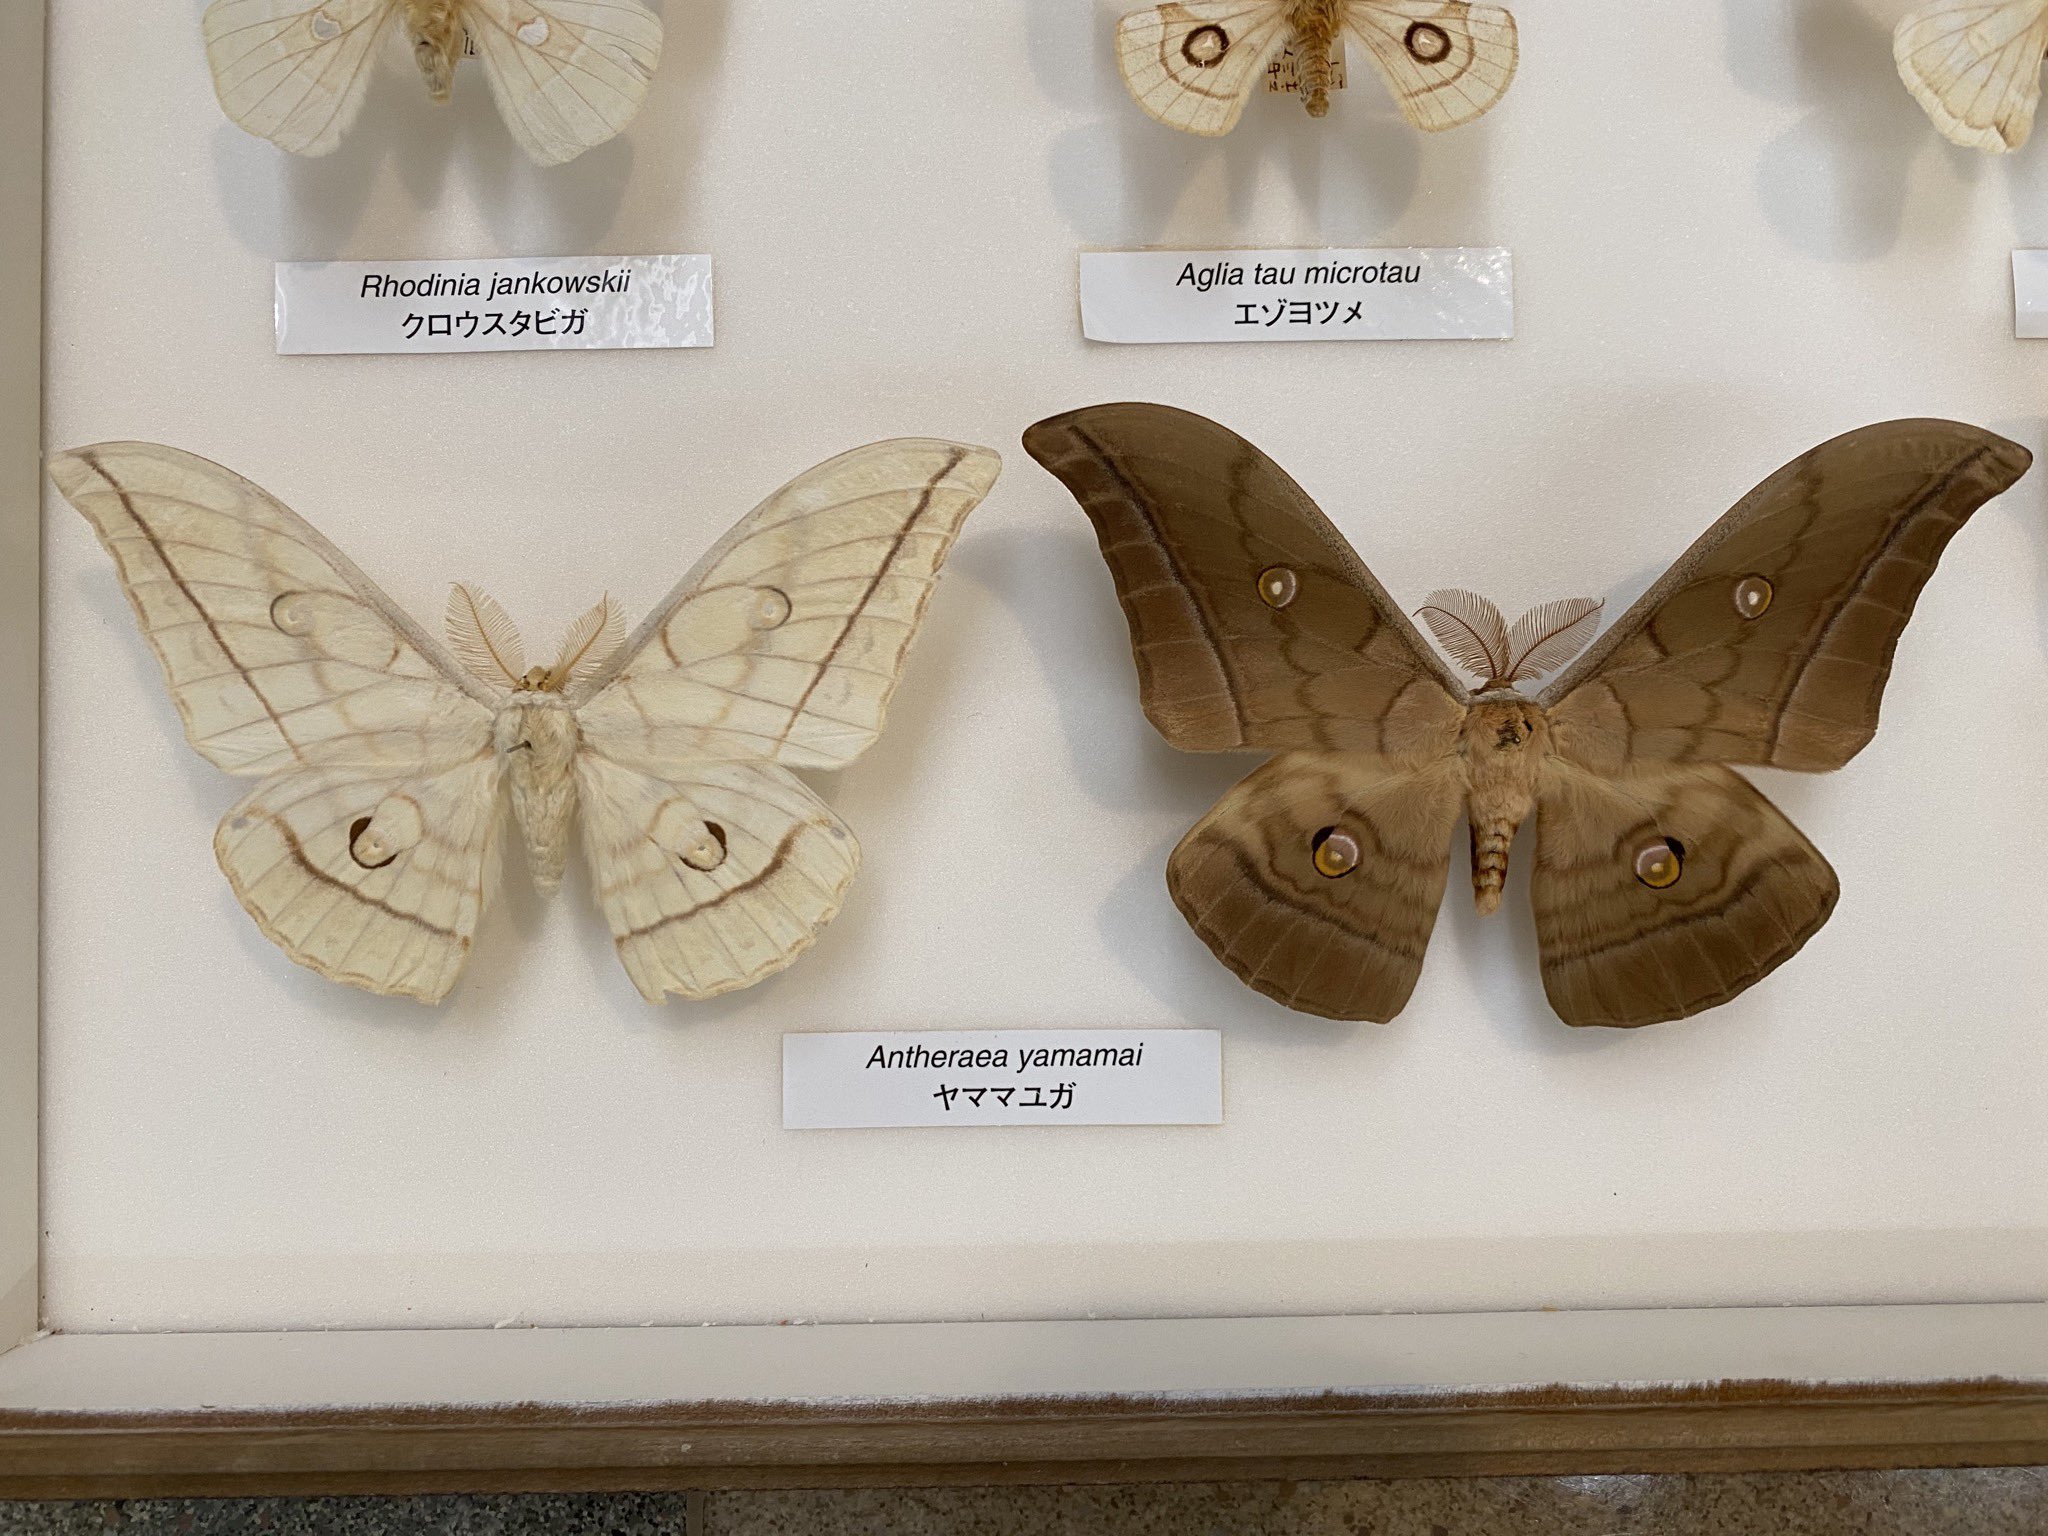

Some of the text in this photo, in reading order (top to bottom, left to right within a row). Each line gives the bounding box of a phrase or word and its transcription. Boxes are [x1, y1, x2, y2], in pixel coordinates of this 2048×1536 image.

[359, 269, 631, 301] Rhodinia jankowskii
[1175, 260, 1421, 293] Aglia tau microtau
[400, 307, 588, 338] クロウスタビガ
[1233, 298, 1364, 328] エゾヨツメ
[865, 1042, 1144, 1074] Antheraea yamamai
[932, 1081, 1078, 1111] ヤママユガ
